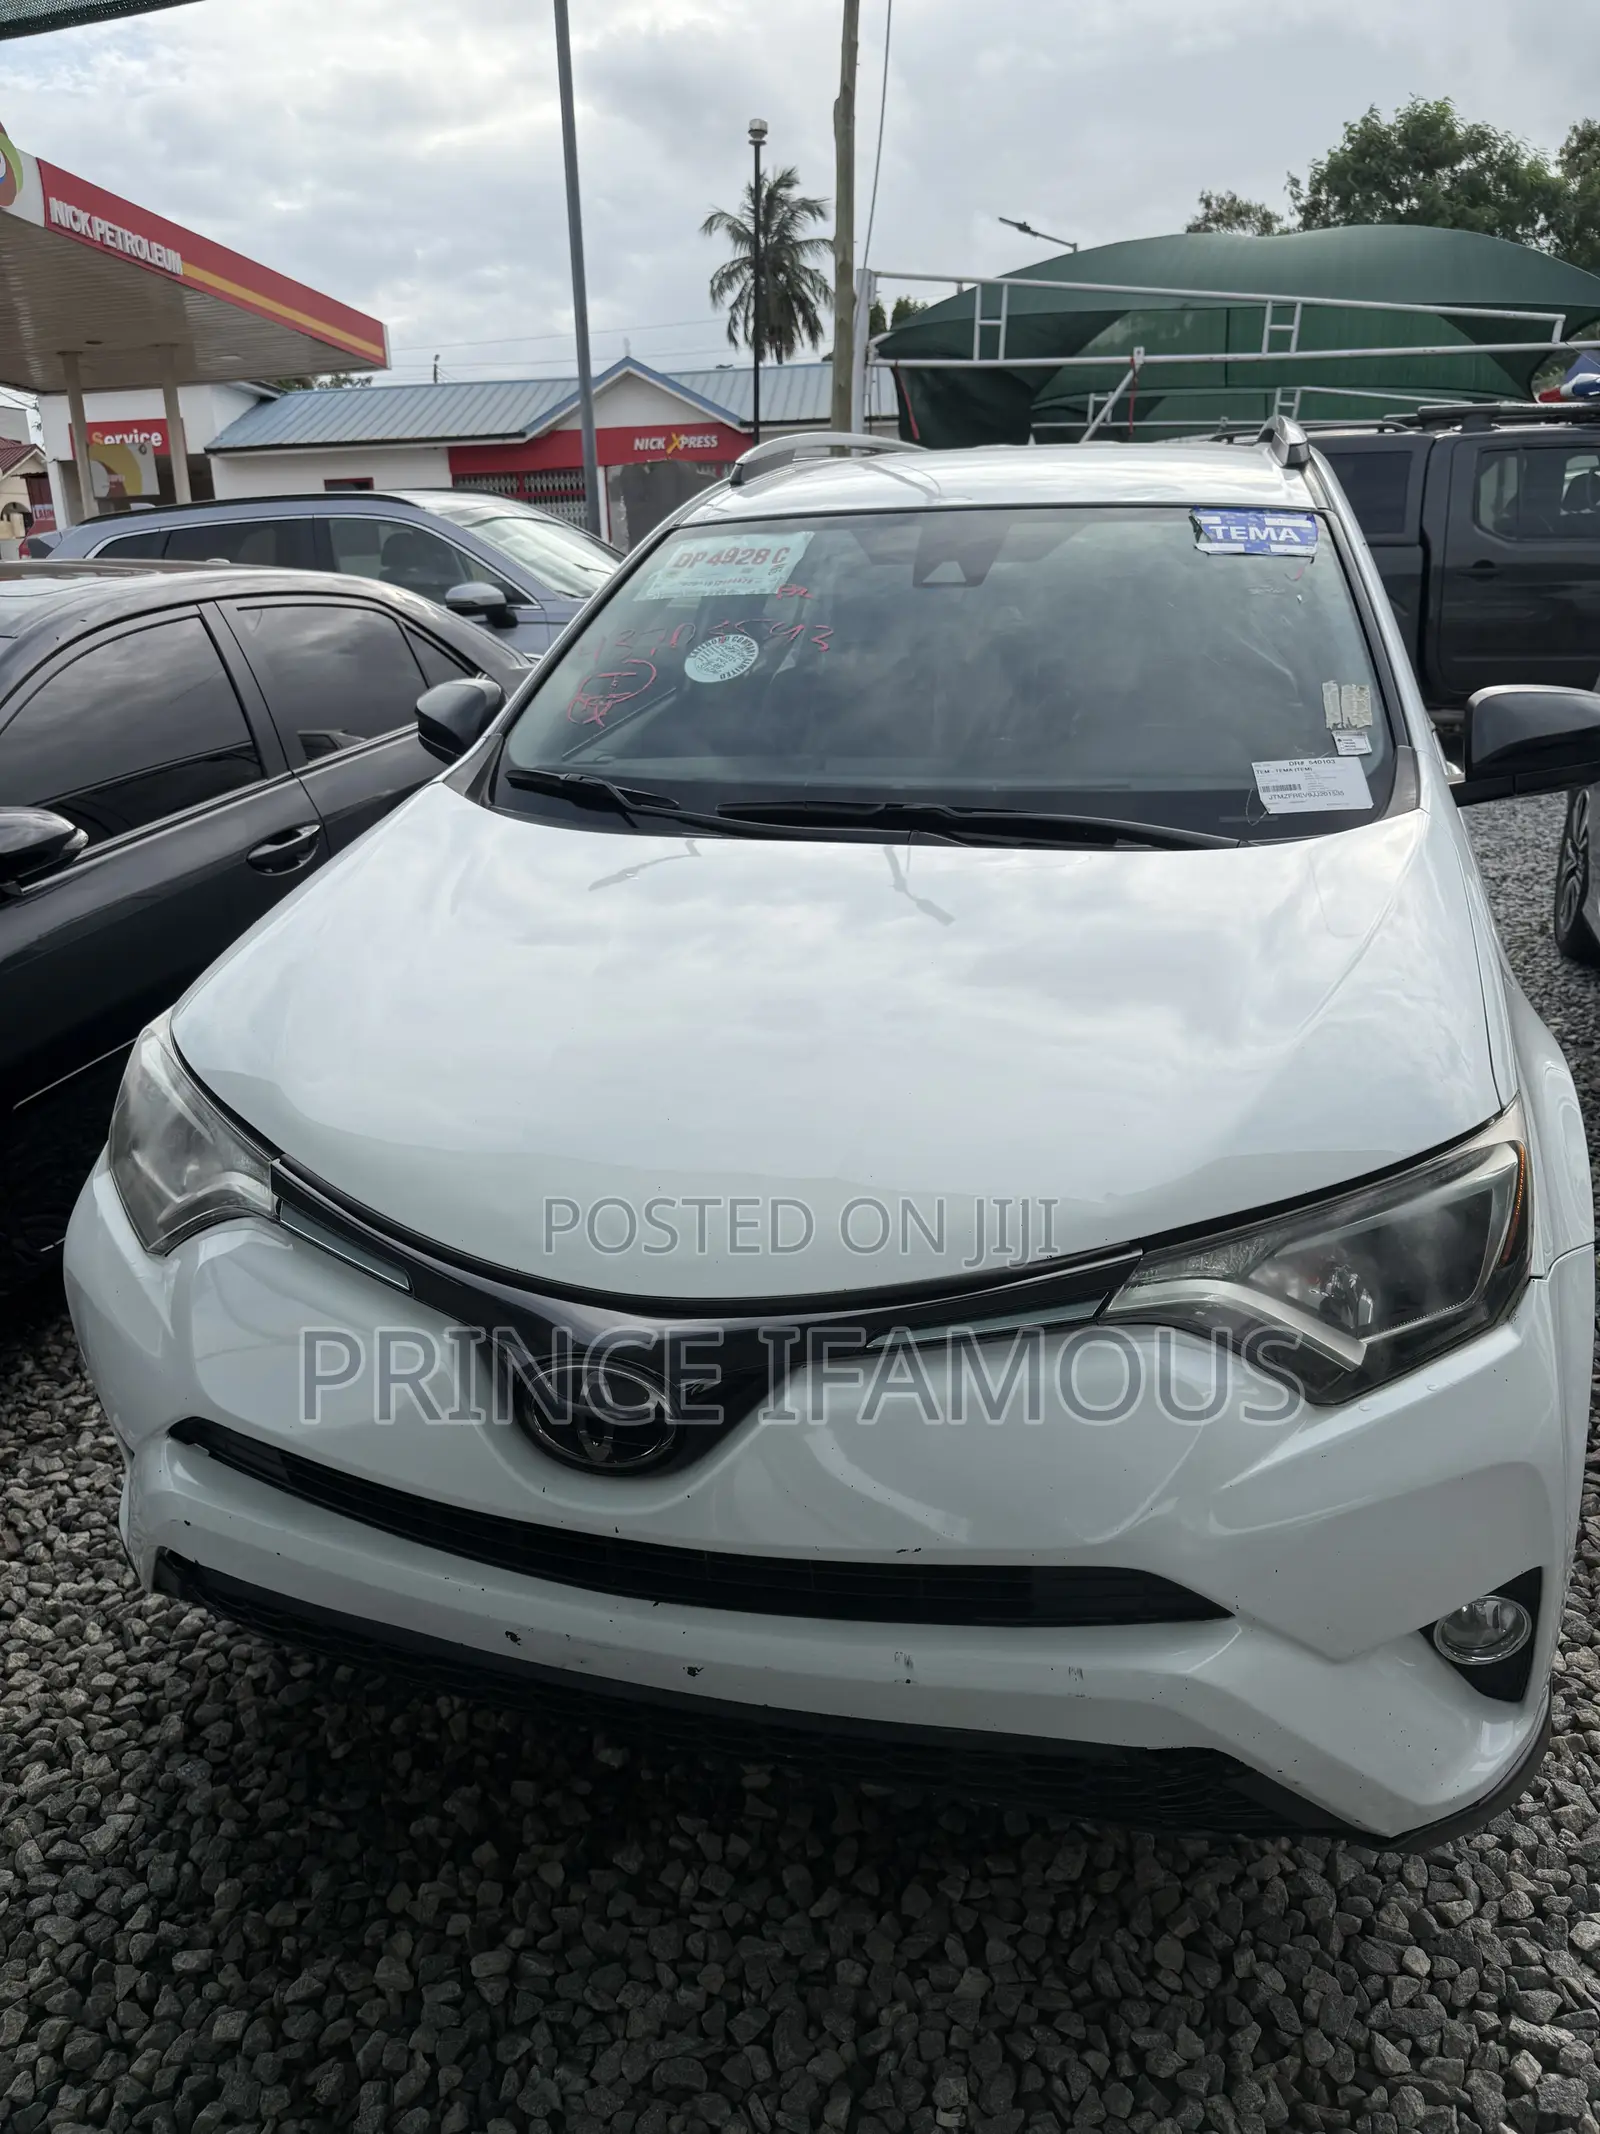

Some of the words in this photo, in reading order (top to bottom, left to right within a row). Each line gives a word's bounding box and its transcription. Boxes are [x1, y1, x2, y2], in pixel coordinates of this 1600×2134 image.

[49, 197, 93, 239] NICK
[91, 216, 183, 275] PETROLEUM
[92, 428, 162, 447] Service
[633, 437, 666, 451] NICK
[666, 432, 719, 454] XPRESS
[1208, 525, 1301, 542] TEMA
[673, 552, 707, 569] DP
[706, 547, 771, 566] 4928
[771, 547, 791, 565] C
